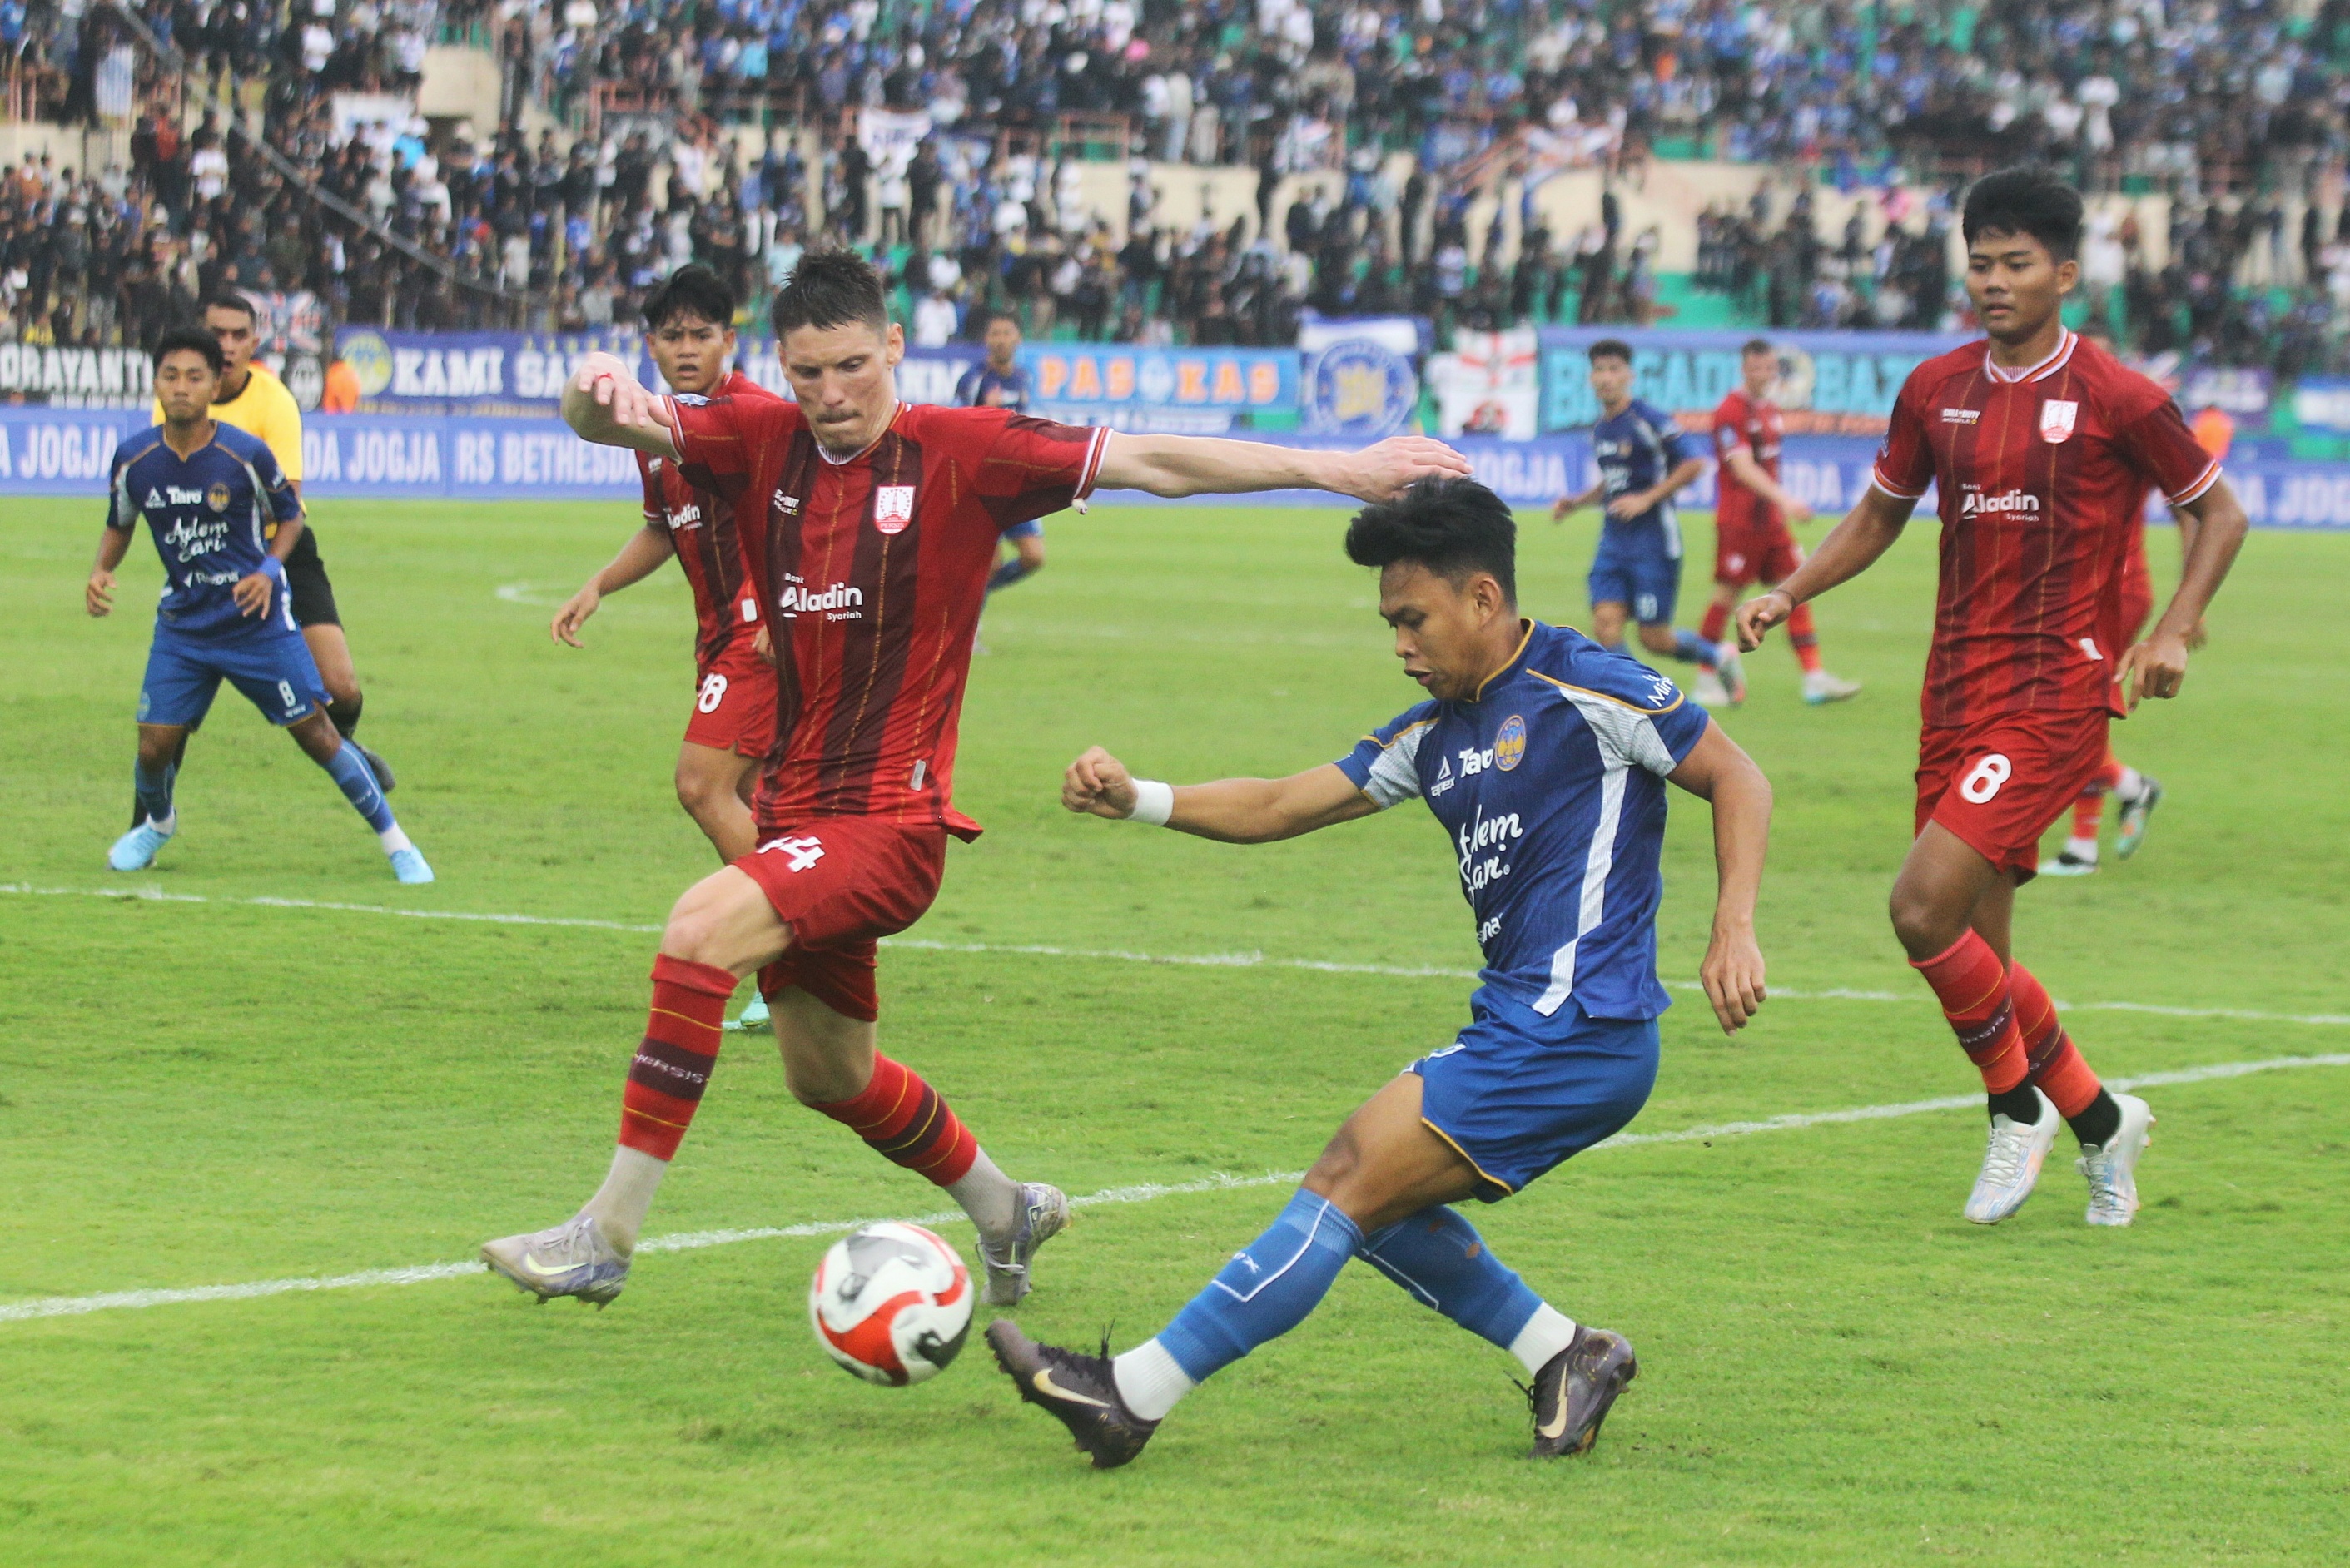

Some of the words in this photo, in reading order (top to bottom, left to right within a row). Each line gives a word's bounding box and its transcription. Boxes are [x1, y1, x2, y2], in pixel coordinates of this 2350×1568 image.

[393, 347, 504, 399] KAMI
[348, 429, 441, 484] JOGJA
[457, 430, 496, 484] RS
[667, 503, 701, 530] ladin
[1962, 489, 2039, 514] Aladin
[784, 573, 805, 584] Bank
[780, 582, 863, 613] Aladin
[827, 611, 862, 623] Syariah
[1960, 753, 2012, 804] 8
